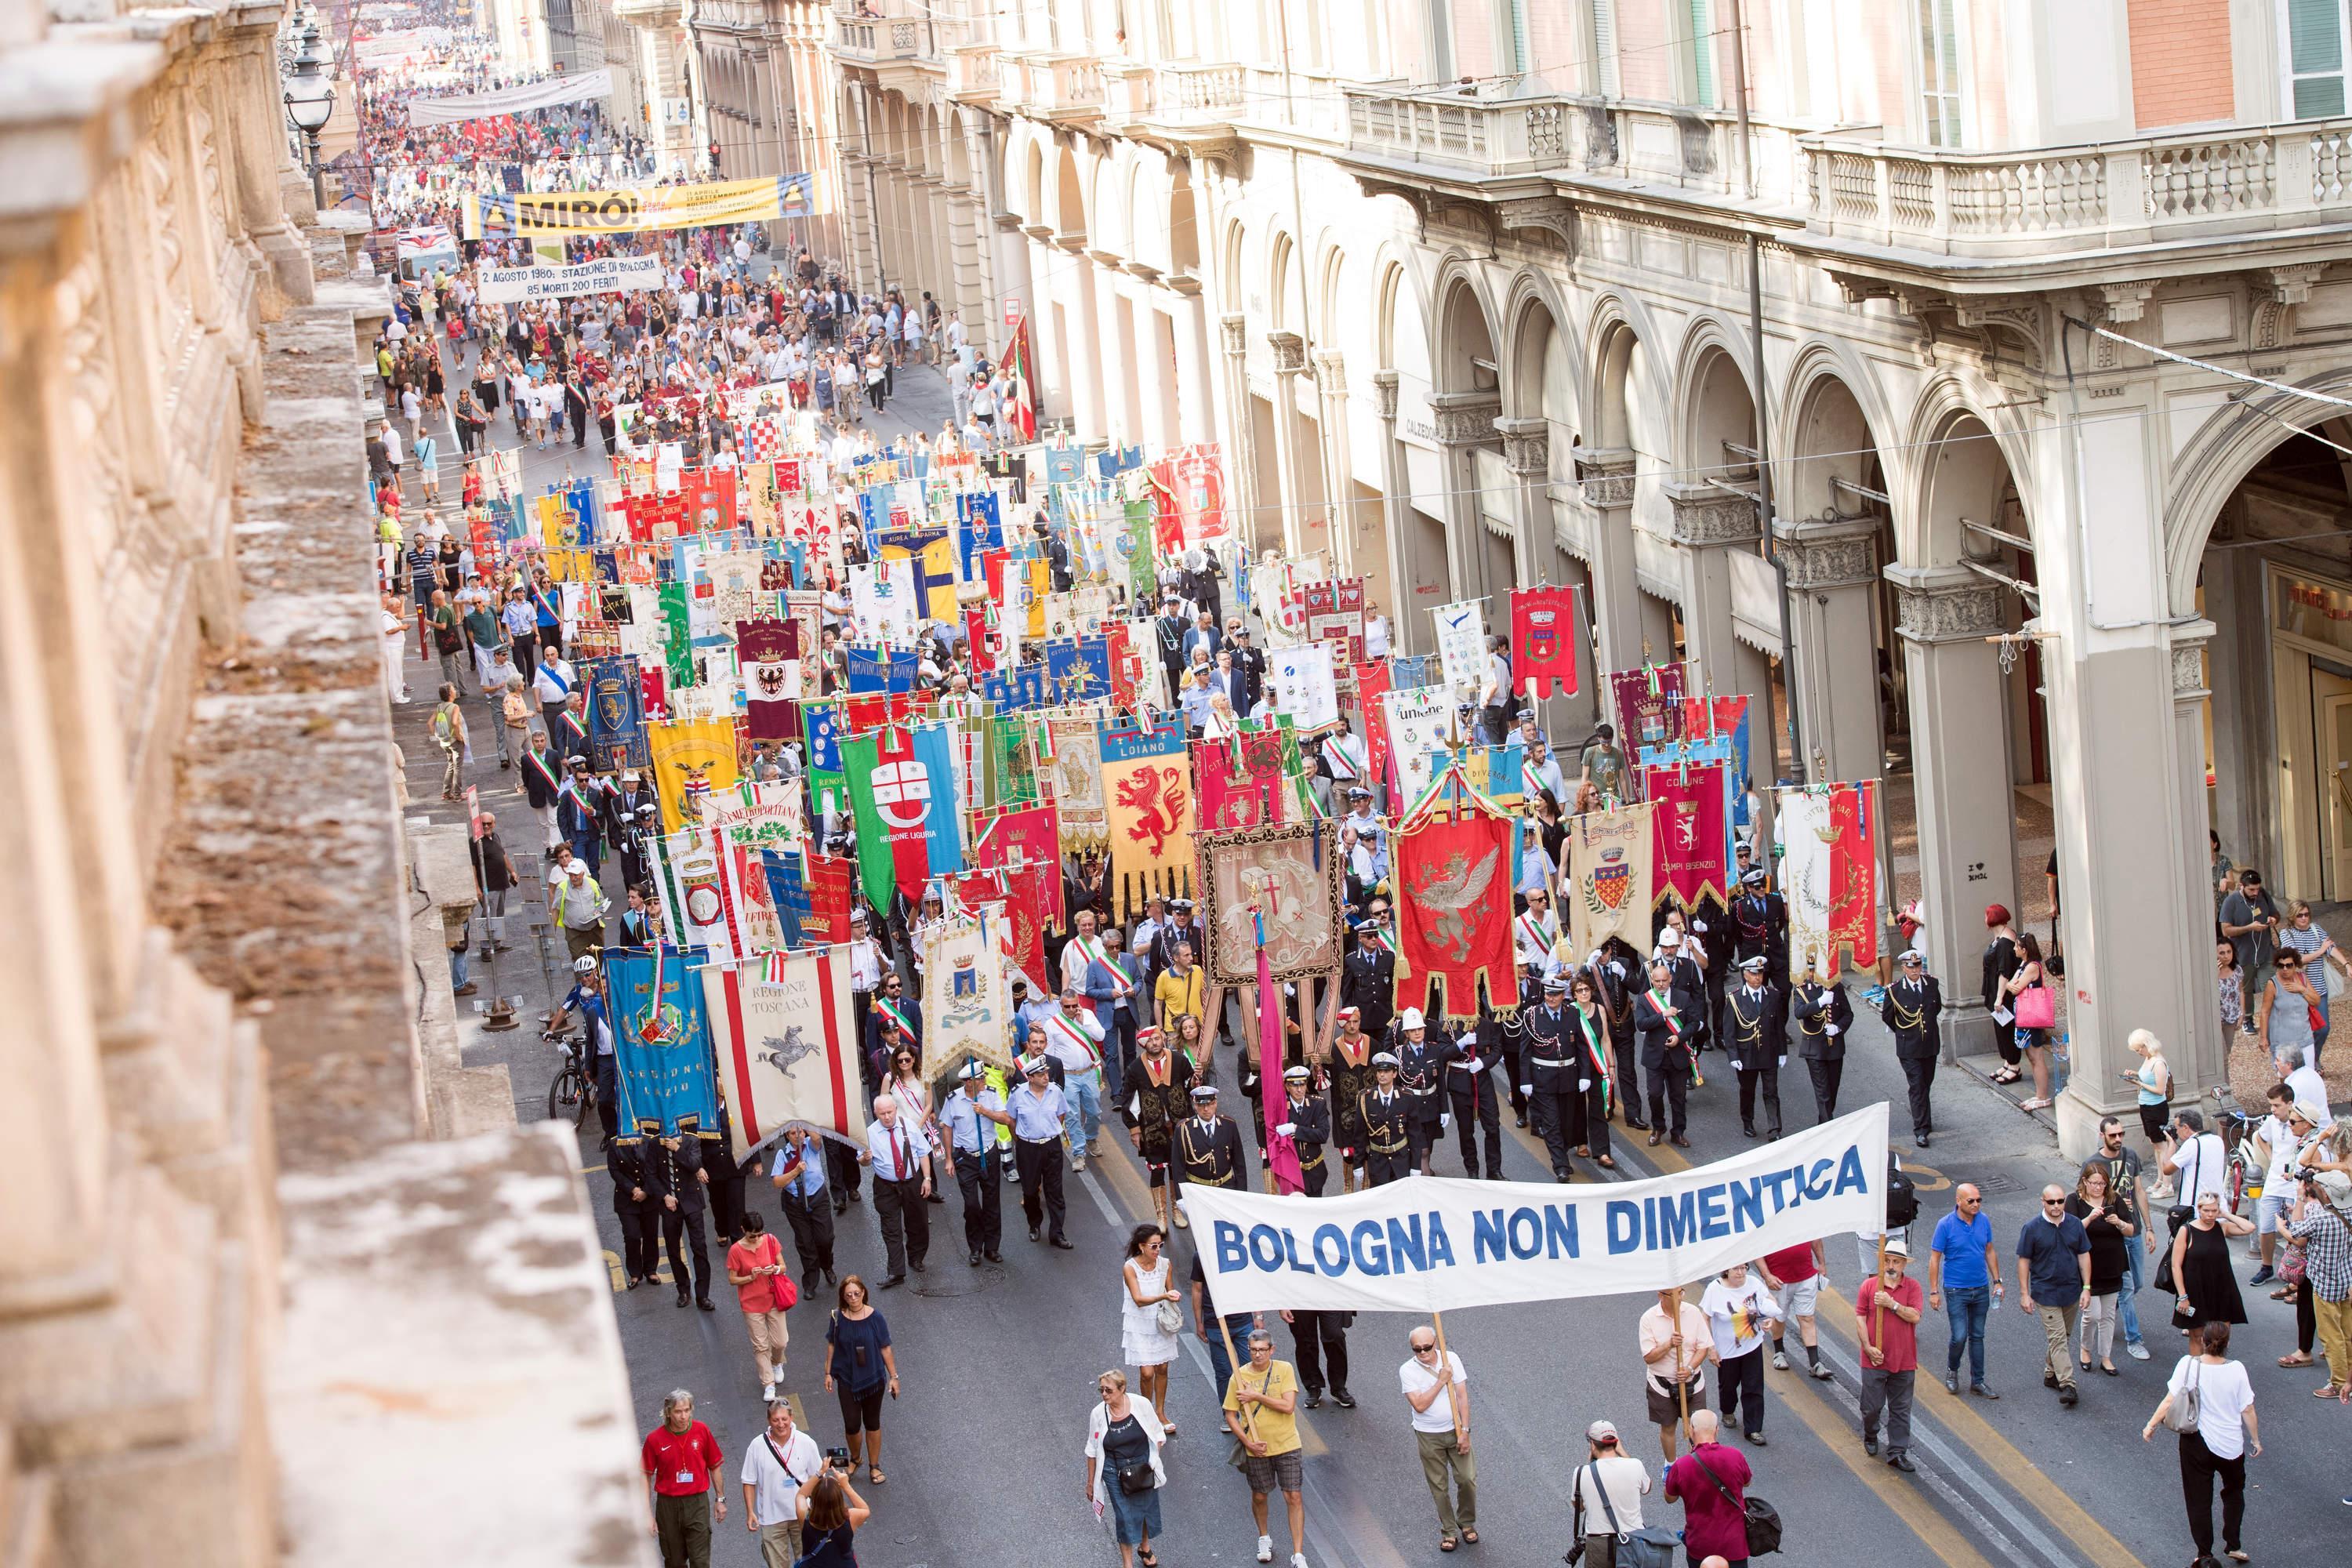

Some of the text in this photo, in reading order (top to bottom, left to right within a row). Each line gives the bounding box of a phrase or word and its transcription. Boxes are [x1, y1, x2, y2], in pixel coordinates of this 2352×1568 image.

[520, 193, 638, 228] MIRÓ!
[482, 259, 656, 283] 2 AGOSTO 1980: STAZIONE DI BOLOGNA
[527, 277, 619, 295] 85 MORTI 200 FERITI
[1633, 695, 1665, 707] BELLNO
[1120, 742, 1165, 757] LOIANO
[818, 778, 840, 786] RENO
[1481, 770, 1512, 785] VERONA
[1666, 776, 1705, 786] COUNE
[732, 804, 797, 820] METROPOLITANA
[879, 829, 937, 844] REGIONE LIGURIA
[1686, 860, 1716, 870] BISENZIO
[753, 980, 807, 998] REGIONE
[752, 996, 810, 1014] TOSCANA
[1213, 1144, 1868, 1277] BOLOGNA NON DIMENTICA
